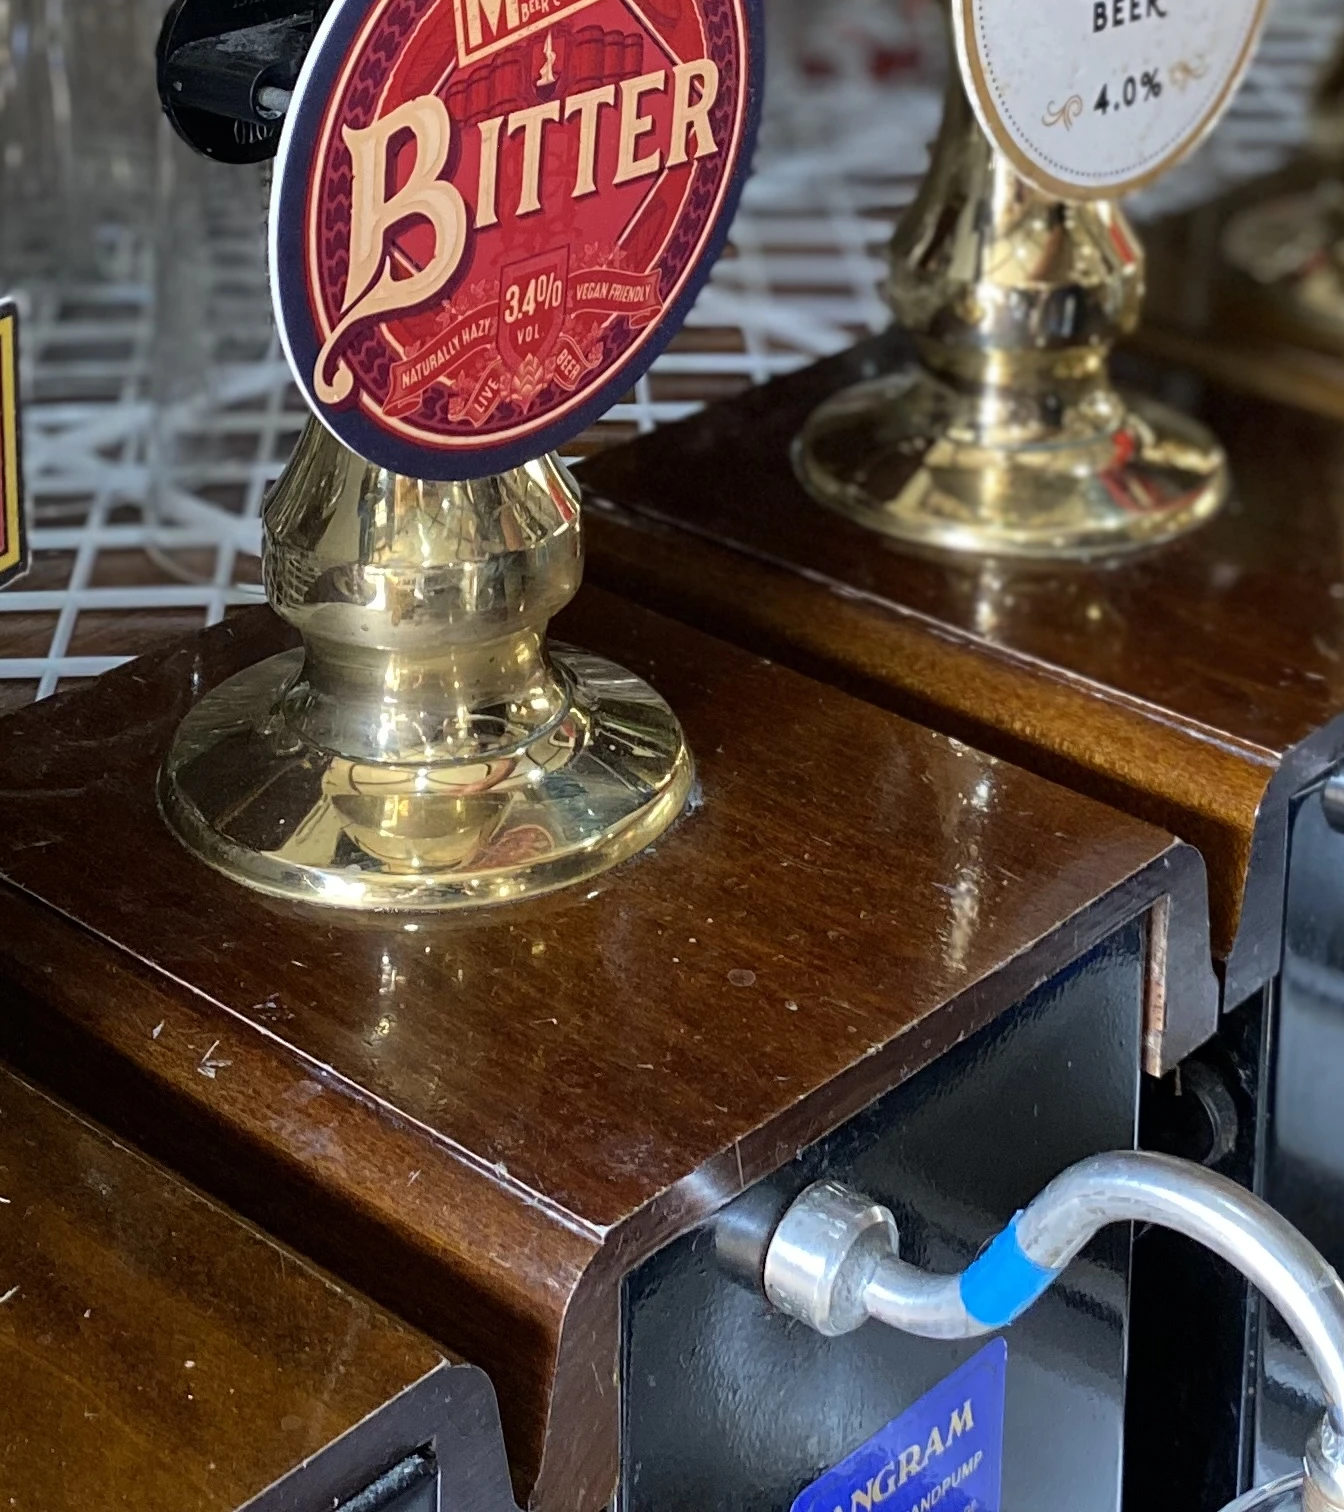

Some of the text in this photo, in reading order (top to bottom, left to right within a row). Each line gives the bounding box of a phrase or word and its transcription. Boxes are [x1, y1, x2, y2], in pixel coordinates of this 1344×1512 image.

[1094, 68, 1163, 115] 4.0%
[314, 58, 718, 404] BITTER
[504, 272, 562, 323] 3.4%
[576, 284, 651, 303] VEGAN FRIENDLY
[400, 317, 492, 389] NATURALLY HAZY
[556, 348, 581, 379] BEER
[473, 375, 500, 413] LIVE
[906, 1450, 984, 1512] ANDPUMP
